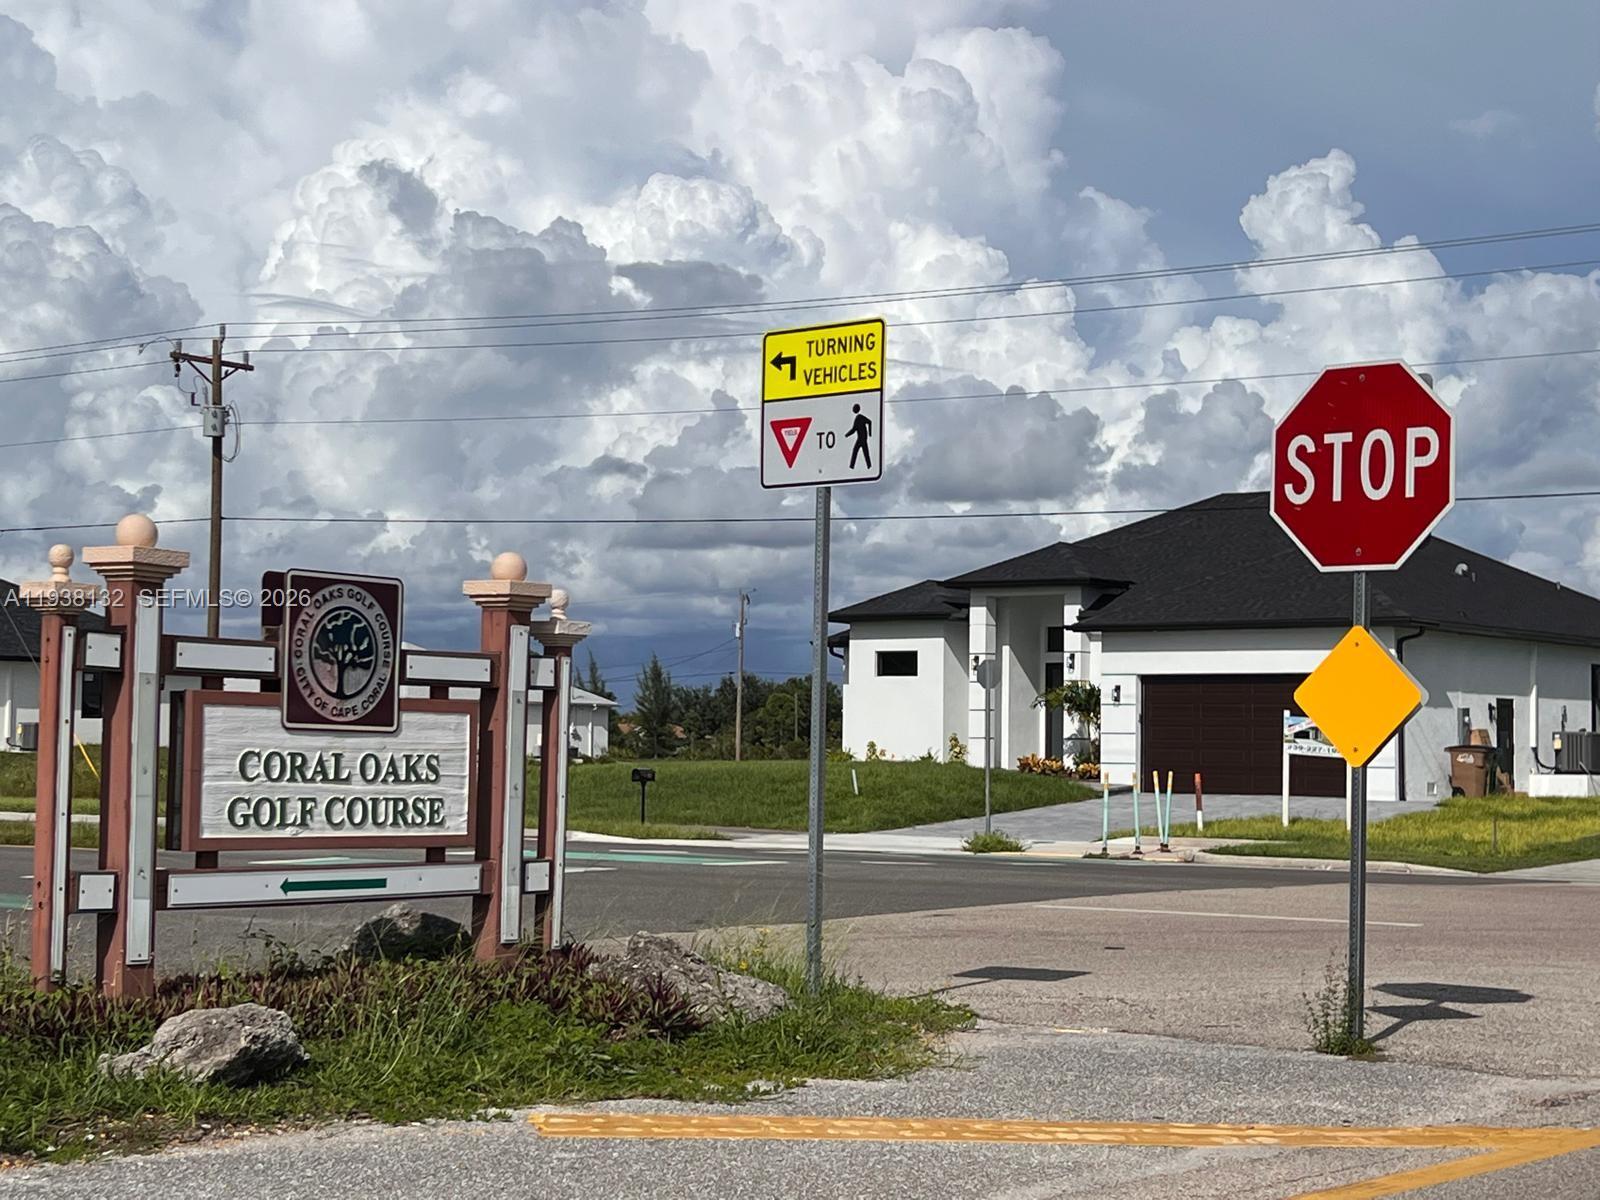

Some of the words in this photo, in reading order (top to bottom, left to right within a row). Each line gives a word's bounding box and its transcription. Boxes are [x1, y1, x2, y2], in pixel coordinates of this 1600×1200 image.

[806, 333, 876, 357] TURNING
[803, 361, 877, 386] VEHICLES
[816, 431, 836, 450] TO
[1283, 426, 1440, 506] STOP
[295, 611, 315, 658] CORAL
[314, 587, 344, 610] OAKS
[347, 588, 376, 611] GOLF
[374, 613, 391, 668] COURSE
[296, 667, 315, 698] CITY
[314, 697, 329, 710] OF
[331, 706, 359, 718] CAPE
[361, 676, 387, 711] CORAL
[238, 750, 351, 784] CORAL
[358, 752, 441, 784] OAKS
[226, 796, 317, 829] GOLF
[324, 796, 446, 828] COURSE
